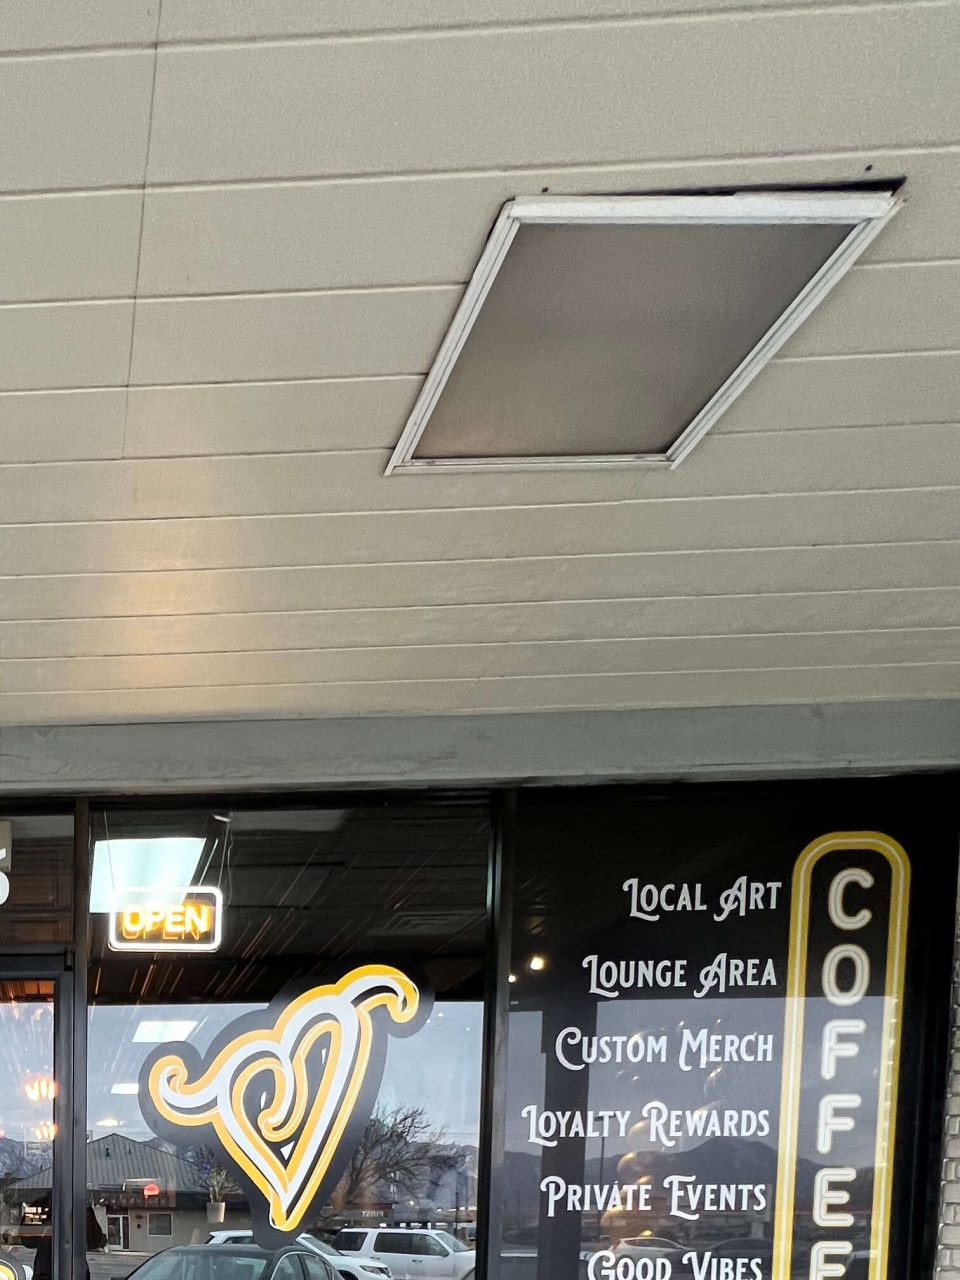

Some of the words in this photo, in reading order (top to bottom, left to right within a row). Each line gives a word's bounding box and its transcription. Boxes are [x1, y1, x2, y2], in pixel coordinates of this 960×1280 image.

[121, 903, 209, 935] OPEN
[622, 877, 707, 921] LOCAL
[713, 875, 782, 921] ART
[582, 954, 687, 998] LOUNGE
[693, 952, 777, 998] AREA
[555, 1026, 668, 1071] CUSTOM
[678, 1027, 774, 1071] MERCH
[521, 1104, 631, 1148] LOYALTY
[641, 1100, 770, 1147] REWARDS
[540, 1175, 652, 1217] PRIVATE
[662, 1174, 766, 1220] EVENTS
